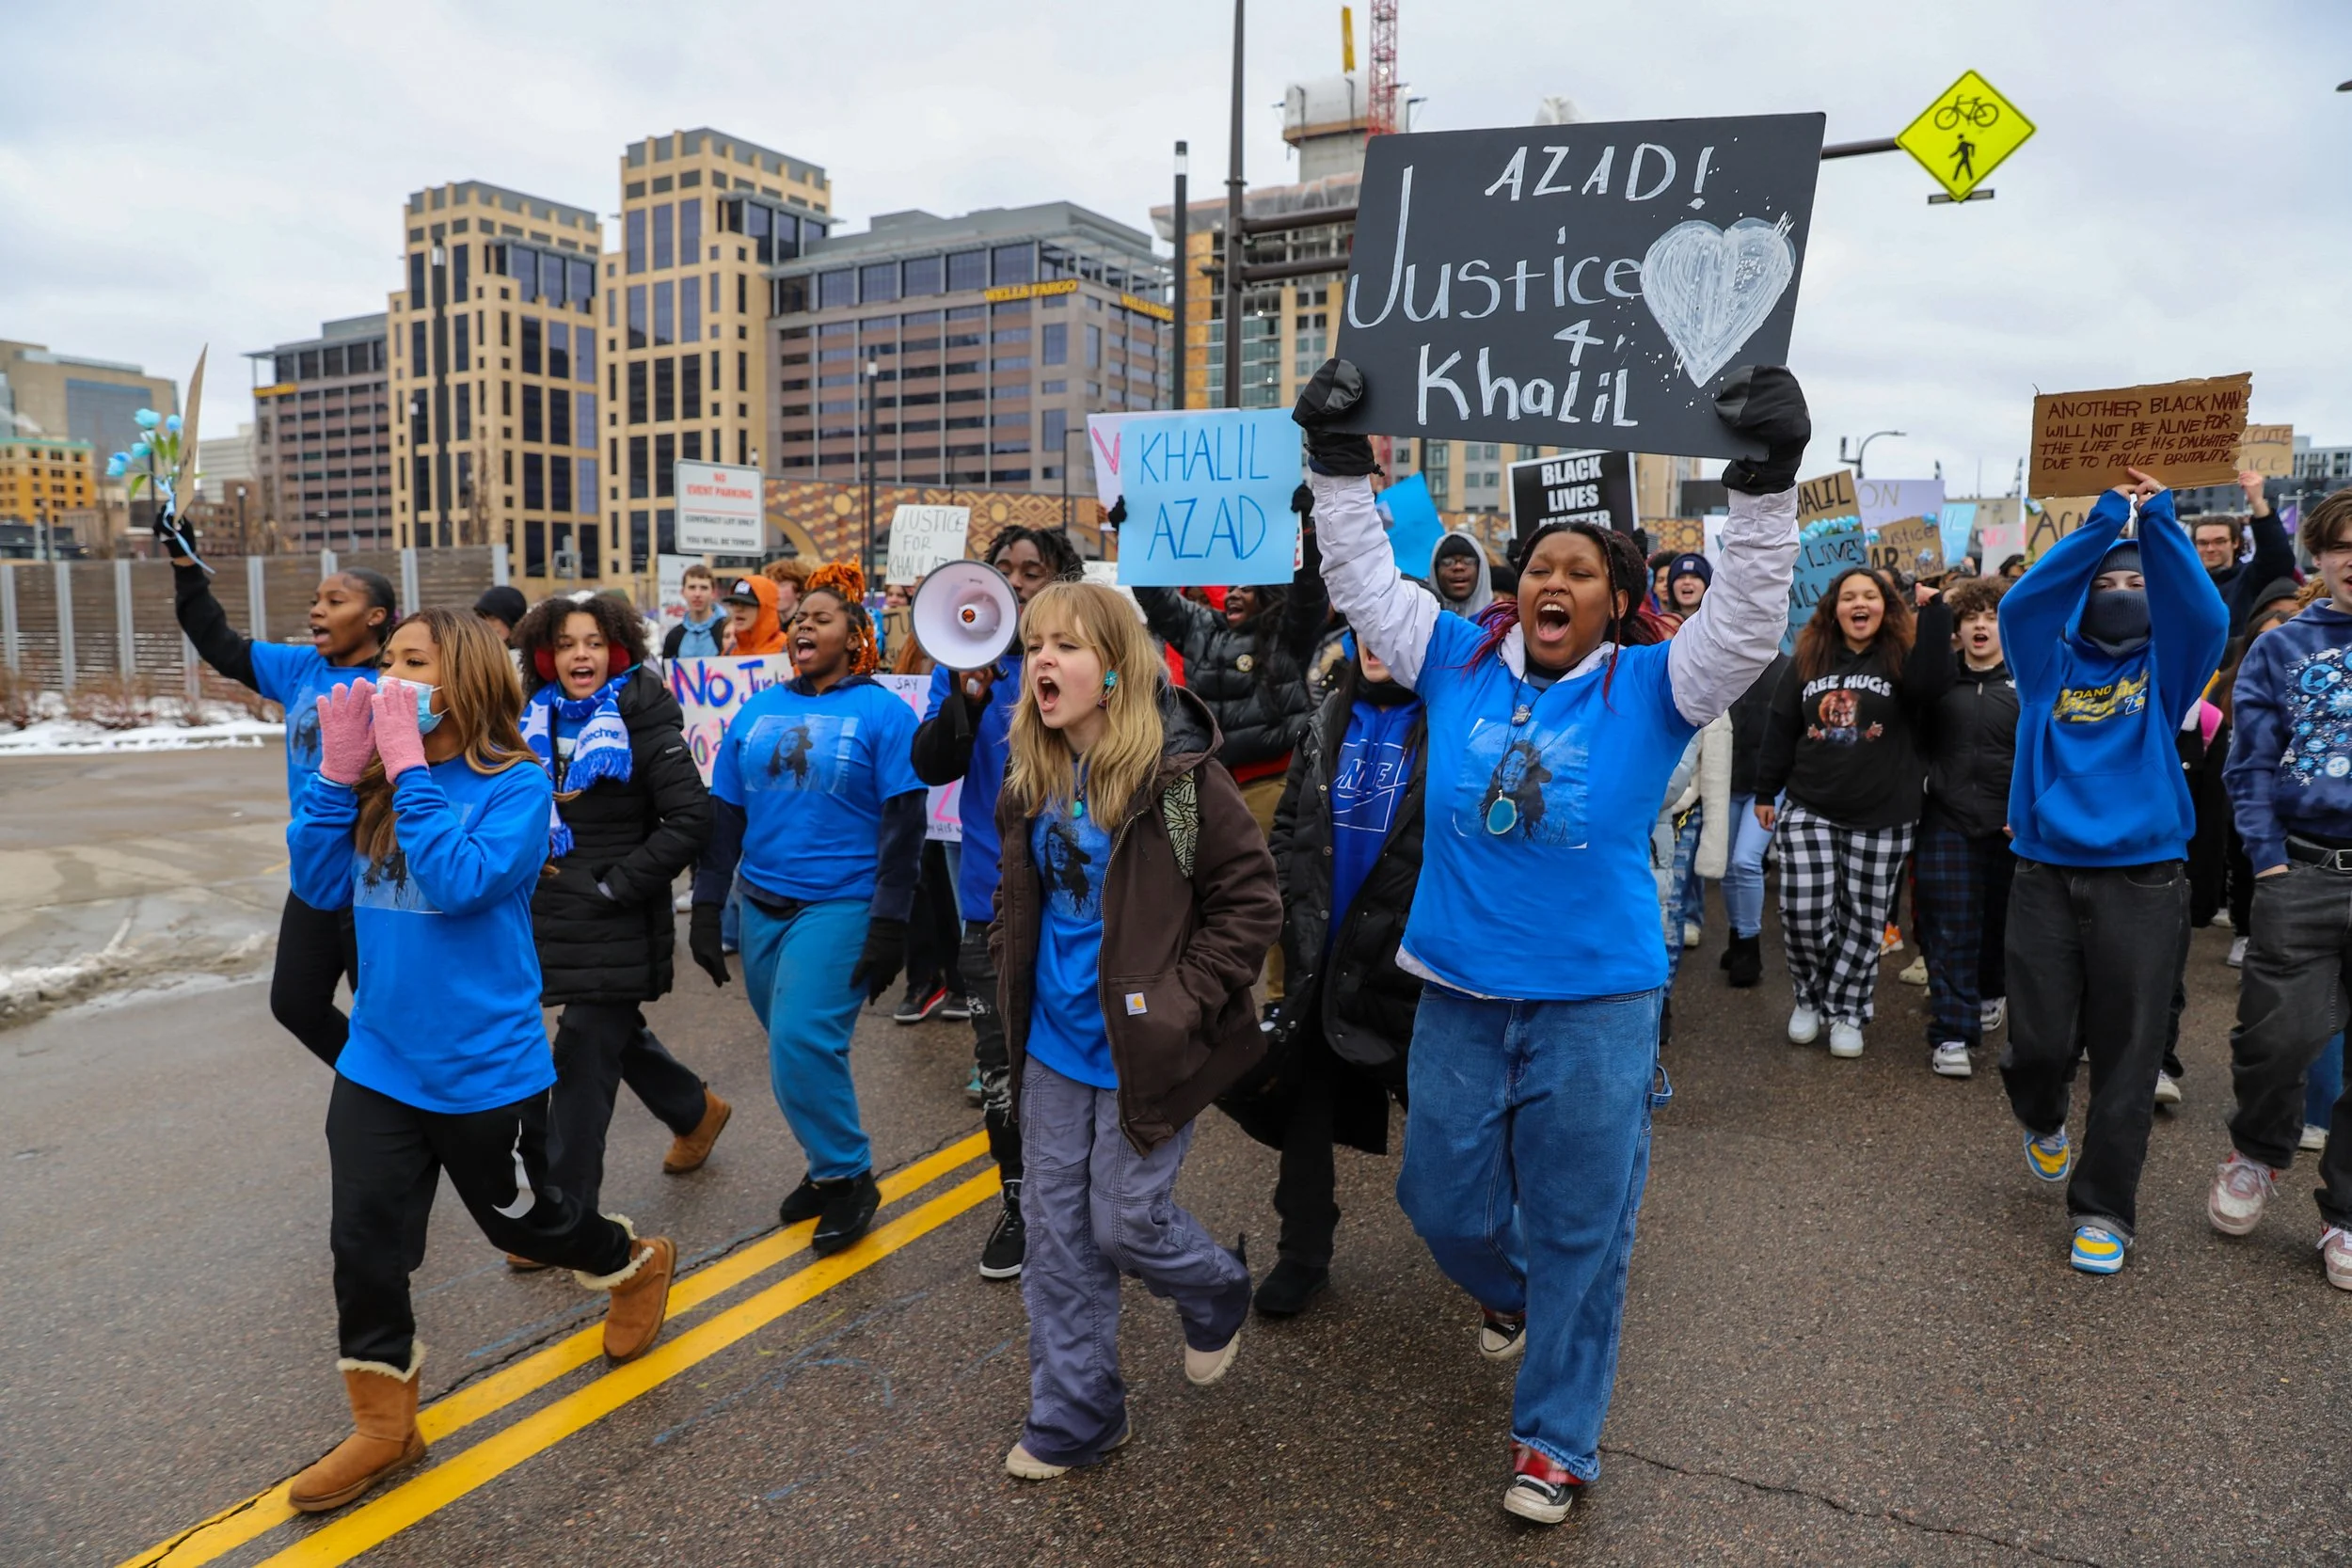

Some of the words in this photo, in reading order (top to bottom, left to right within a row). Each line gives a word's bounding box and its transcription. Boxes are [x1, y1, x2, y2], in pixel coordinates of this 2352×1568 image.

[1485, 143, 1715, 211] AZAD!
[1347, 165, 1644, 329] Justice
[1554, 320, 1604, 367] 4
[2048, 401, 2141, 420] ANOTHER
[2150, 395, 2209, 414] BLACK
[2211, 390, 2242, 411] MAN
[2046, 424, 2085, 438] WILL
[2091, 423, 2124, 439] NOT
[2131, 421, 2154, 437] BE
[2157, 418, 2201, 436] ALIVE
[2203, 412, 2232, 431] FOR
[1140, 423, 1269, 484] KHALIL
[2040, 442, 2073, 455] THE
[2079, 439, 2117, 453] LIFE
[2122, 436, 2146, 451] OF
[2151, 436, 2176, 451] HIS
[2178, 431, 2239, 450] DAUGHTER
[1541, 455, 1603, 487] BLACK
[2042, 456, 2074, 470] DUE
[2080, 455, 2099, 468] TO
[2107, 452, 2159, 468] POLICE
[2163, 449, 2230, 466] BRUTALITY.
[712, 472, 727, 483] NO
[715, 486, 754, 499] PARKING
[1548, 483, 1599, 513] LIVES
[894, 509, 965, 533] JUSTICE
[1147, 495, 1266, 562] AZAD
[903, 534, 931, 552] FOR
[1804, 537, 1867, 569] LIVES
[1843, 674, 1893, 697] HUGS
